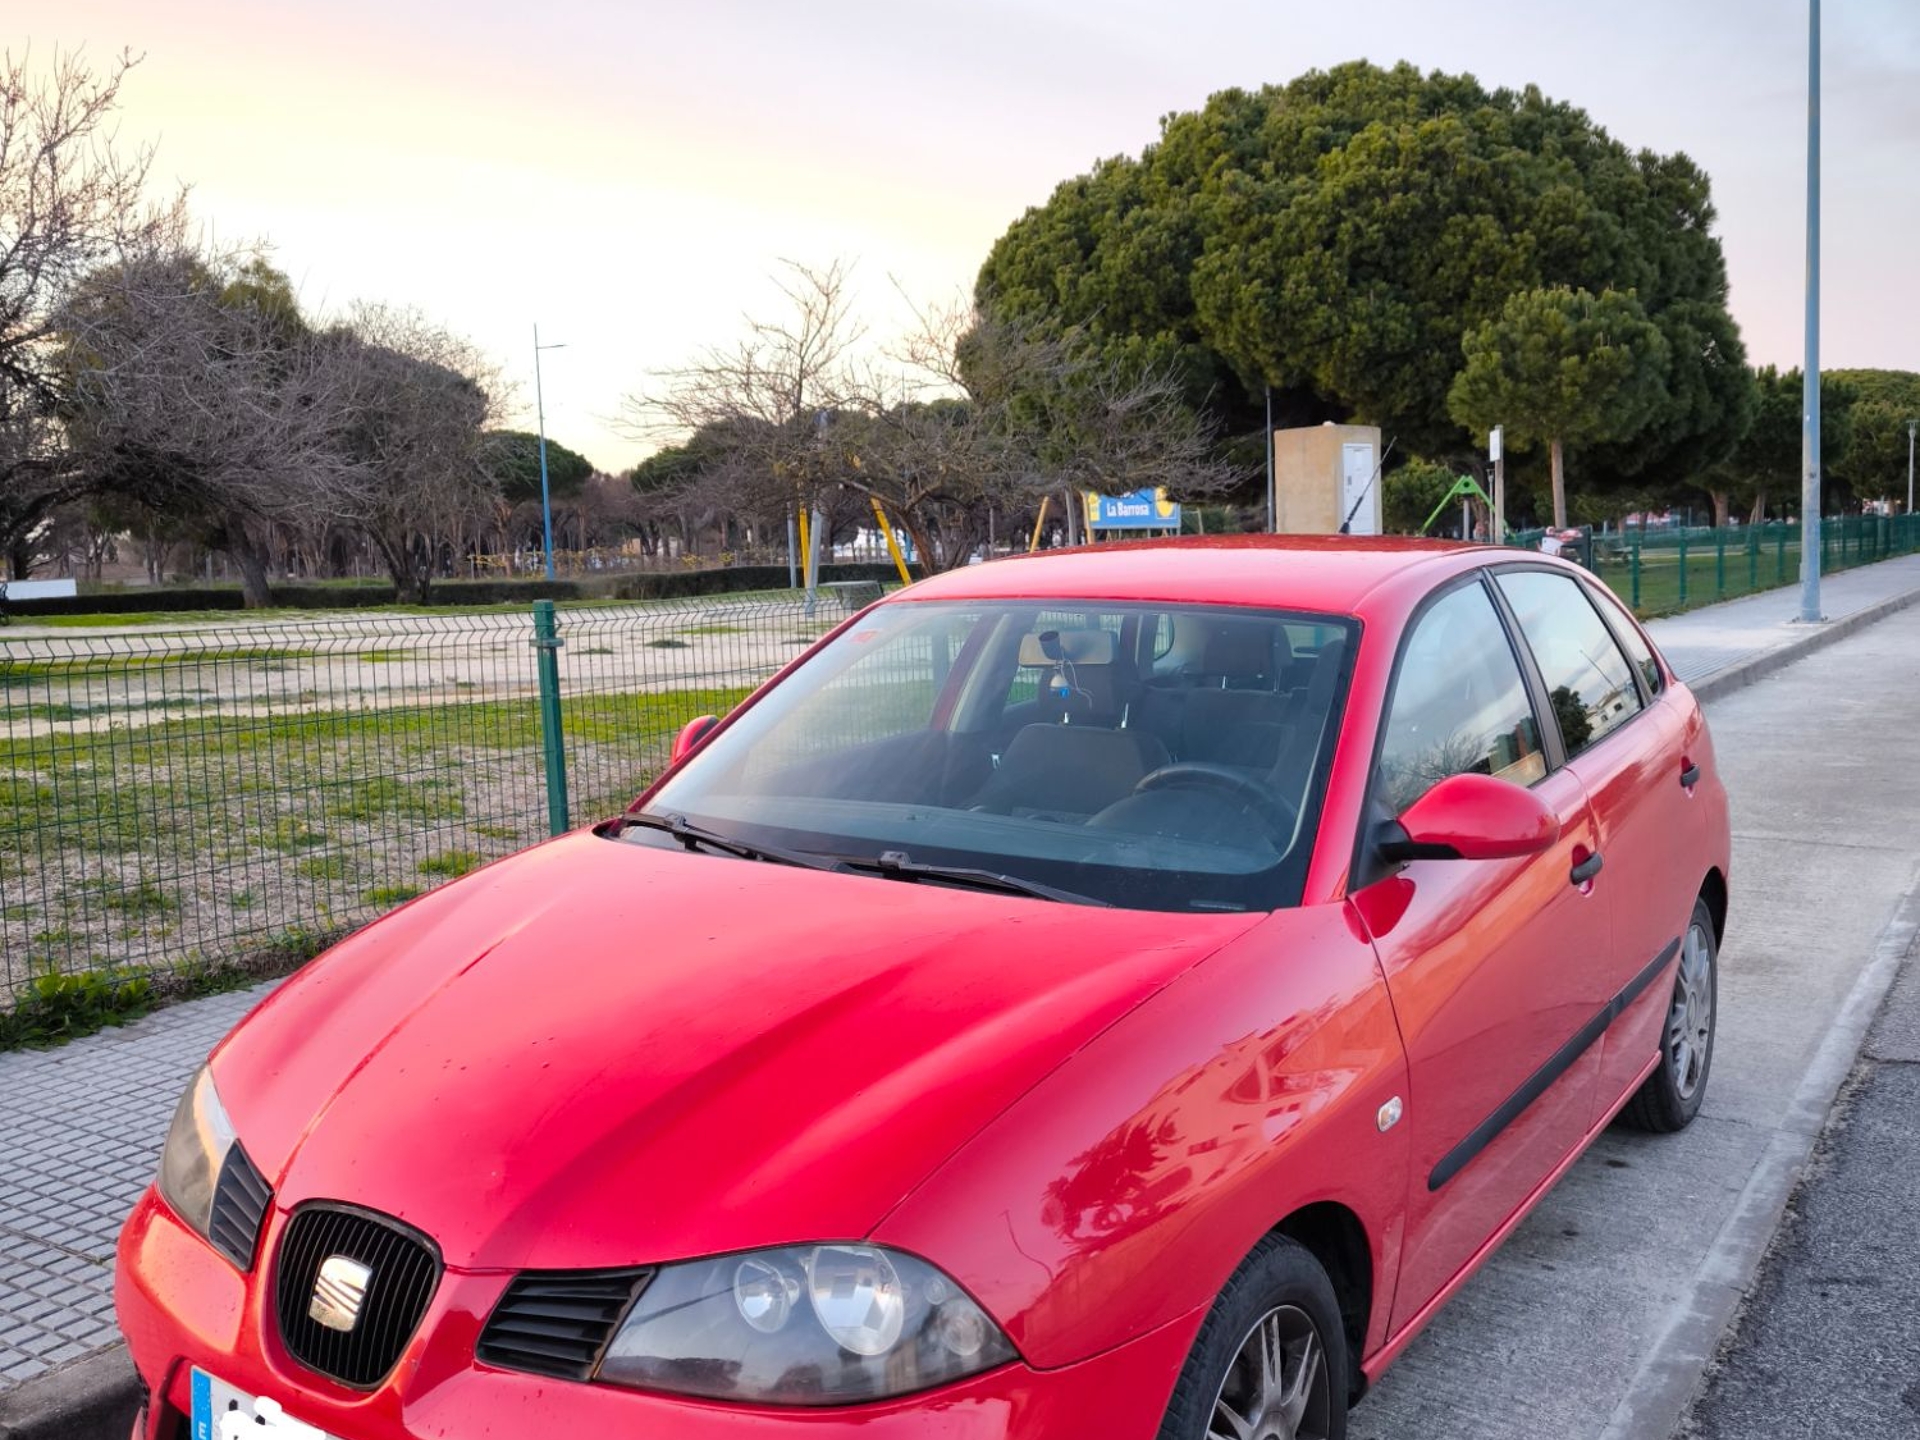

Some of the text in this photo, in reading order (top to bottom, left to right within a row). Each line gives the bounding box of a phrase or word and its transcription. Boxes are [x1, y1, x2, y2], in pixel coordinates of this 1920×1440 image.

[1106, 502, 1150, 517] La Barrosa
[198, 1421, 207, 1440] E
